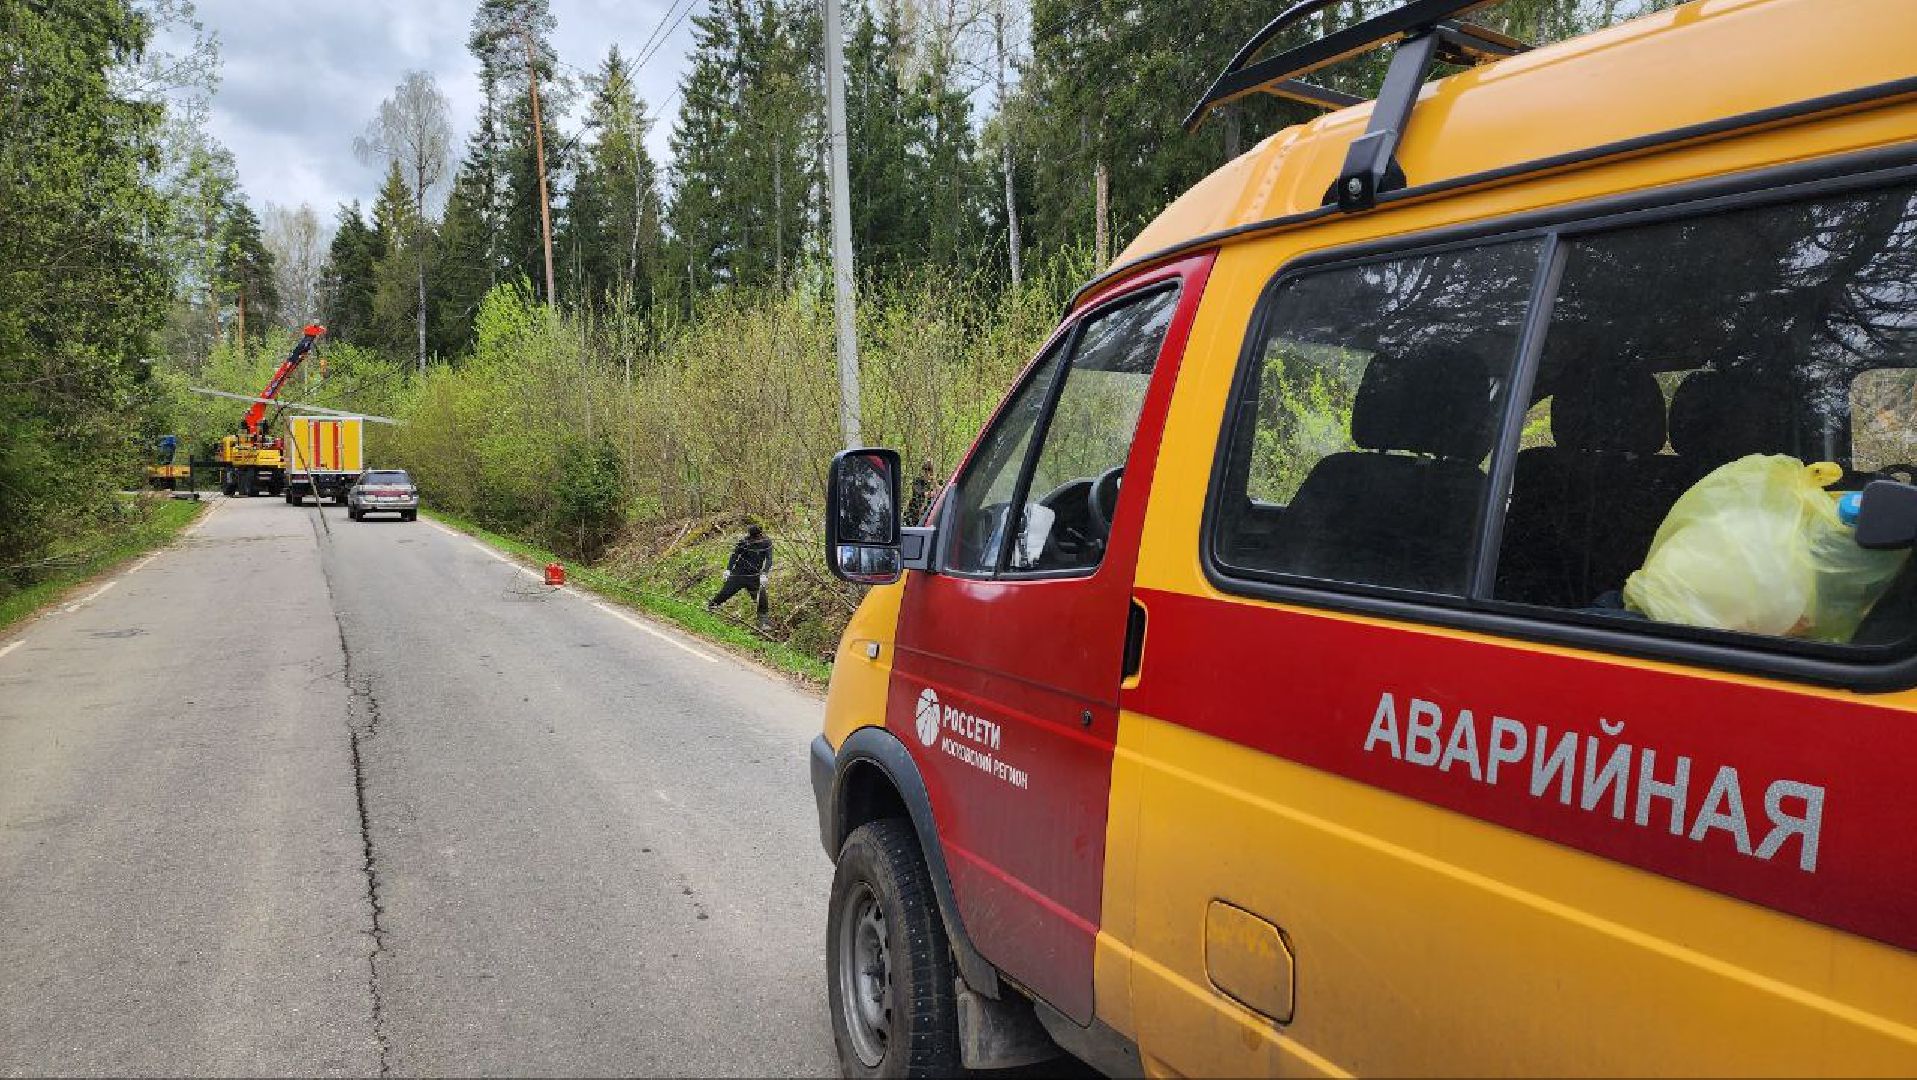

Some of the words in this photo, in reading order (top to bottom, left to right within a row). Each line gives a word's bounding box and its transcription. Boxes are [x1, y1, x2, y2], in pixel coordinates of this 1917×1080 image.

[942, 705, 1000, 750] РОССЕТИ
[942, 737, 992, 773] МОСКОВСКИЙ
[993, 759, 1028, 790] РЕГИОН
[1363, 692, 1825, 874] АВАРИЙНАЯ
